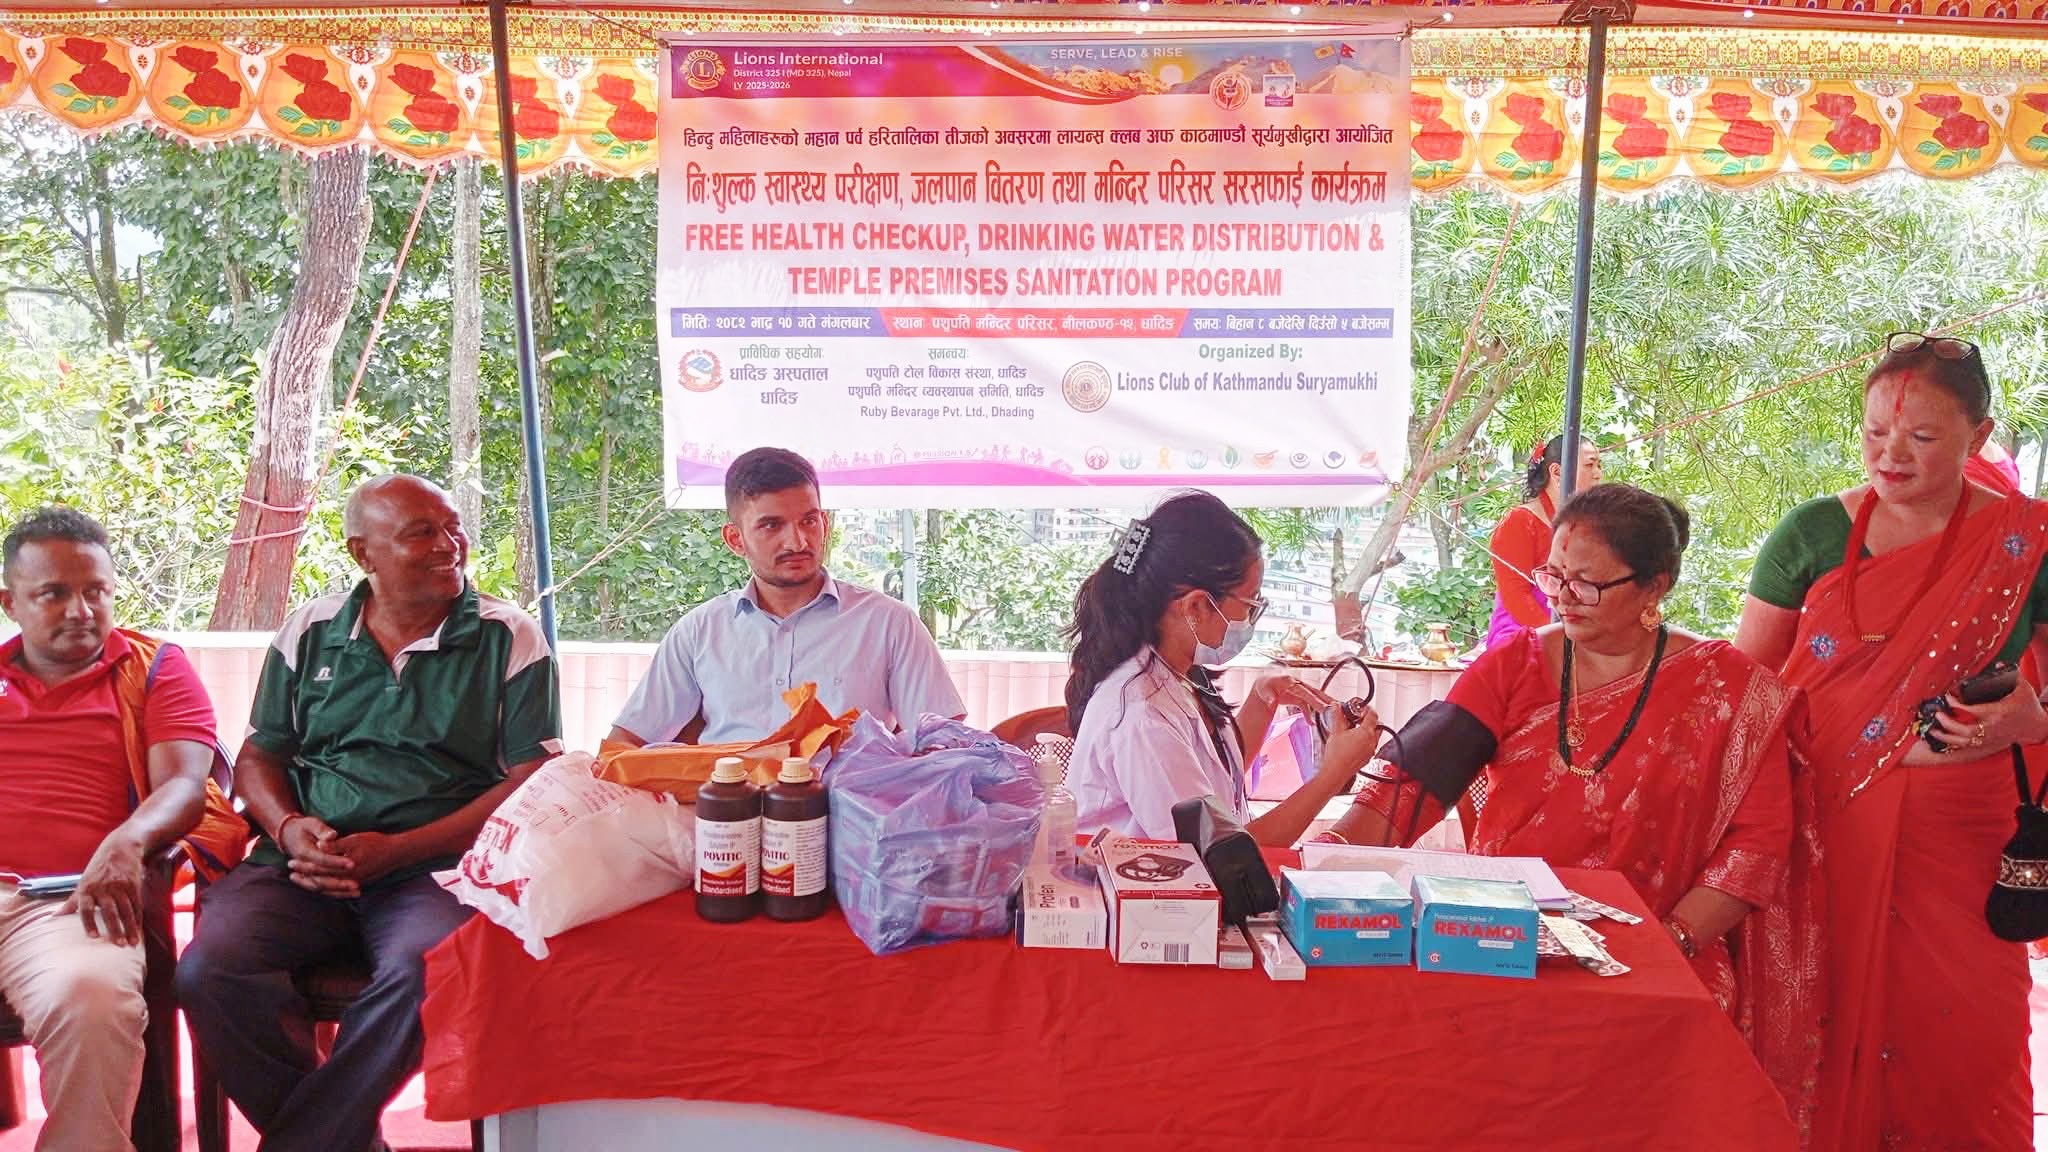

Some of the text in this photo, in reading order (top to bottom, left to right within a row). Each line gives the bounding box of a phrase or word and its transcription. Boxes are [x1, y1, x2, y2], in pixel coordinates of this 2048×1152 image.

[734, 52, 883, 65] Lions International
[1051, 48, 1183, 60] SERVE, LEAD & RISE
[734, 69, 763, 77] District
[766, 69, 780, 77] 325
[806, 69, 825, 78] 325),
[828, 69, 851, 78] Nepal
[805, 132, 839, 147] महान
[846, 128, 863, 146] पर्व
[869, 127, 939, 146] हरितालिका
[945, 126, 988, 146] तीजको
[995, 129, 1051, 145] अवसरमा
[1057, 130, 1104, 145] लायन्स
[1111, 130, 1141, 144] क्लब
[1147, 130, 1174, 144] अफ
[1336, 124, 1394, 143] आयोजित
[765, 171, 826, 206] स्वास्थ्य
[835, 162, 903, 210] परीक्षण,
[911, 172, 977, 204] जलपान
[986, 159, 1045, 204] वितरण
[1052, 172, 1086, 204] तथा
[1094, 159, 1150, 205] मन्दिर
[1158, 159, 1216, 205] परिसर
[1223, 161, 1304, 208] सरसफाई
[1312, 161, 1387, 205] कार्यक्रम
[687, 223, 1384, 257] FREE HEALTH CHECKUP, DRINKING WATER DISTRIBUTION &
[789, 267, 1281, 297] TEMPLE PREMISES SANITATION PROGRAM
[716, 316, 745, 329] २०८२
[798, 313, 816, 329] गते
[739, 344, 780, 359] प्राविधिक
[1199, 344, 1302, 362] Organized By:
[773, 367, 828, 381] अस्पताल
[866, 365, 899, 381] पशुपति
[904, 365, 924, 378] टोल
[929, 365, 960, 378] विकास
[848, 383, 881, 399] पशुपति
[886, 384, 917, 397] मन्दिर
[923, 386, 973, 397] व्यवस्थापन
[979, 384, 1011, 398] समिति,
[1118, 373, 1154, 391] Lions
[1159, 372, 1190, 391] Club
[1195, 372, 1208, 391] of
[1213, 372, 1292, 391] Kathmandu
[1296, 371, 1377, 395] Suryamukhi
[861, 406, 1034, 419] Ruby Bevarage Pvt. Ltd., Dhading
[1314, 912, 1404, 929] REXAMOL
[1433, 918, 1529, 941] REXAMOL
